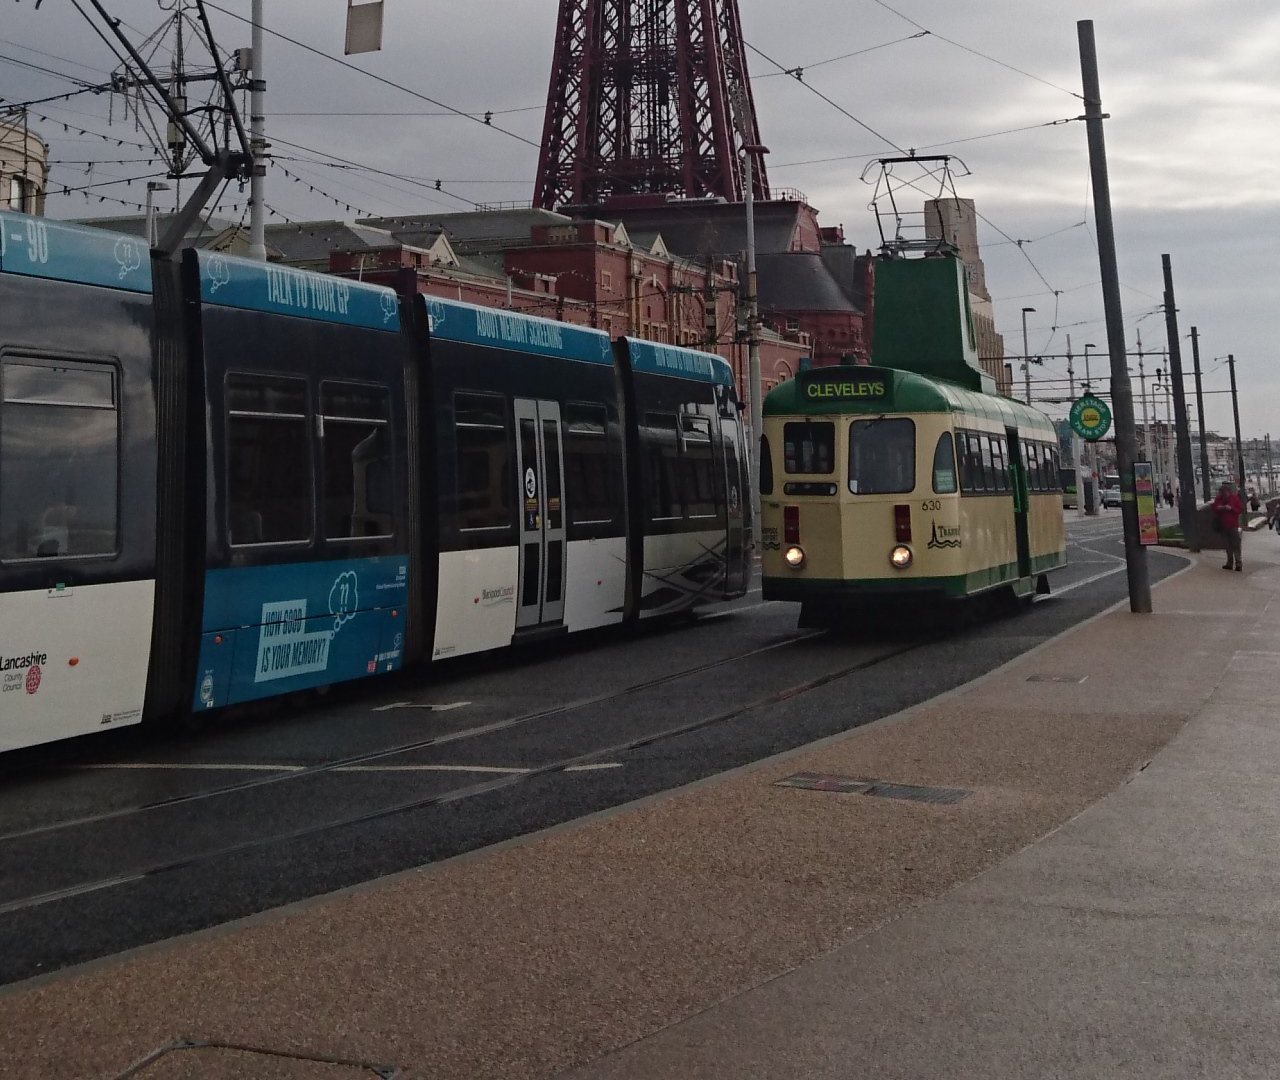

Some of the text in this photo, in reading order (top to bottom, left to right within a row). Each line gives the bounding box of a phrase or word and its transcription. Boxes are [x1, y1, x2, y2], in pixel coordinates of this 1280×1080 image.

[26, 219, 49, 265] 90
[265, 266, 350, 315] TALK TO YOUR GP
[807, 382, 885, 398] CLEVELEYS
[921, 500, 941, 511] 630
[263, 607, 303, 638] HOW GOOD
[261, 637, 327, 673] IS YOUR MEMORY?
